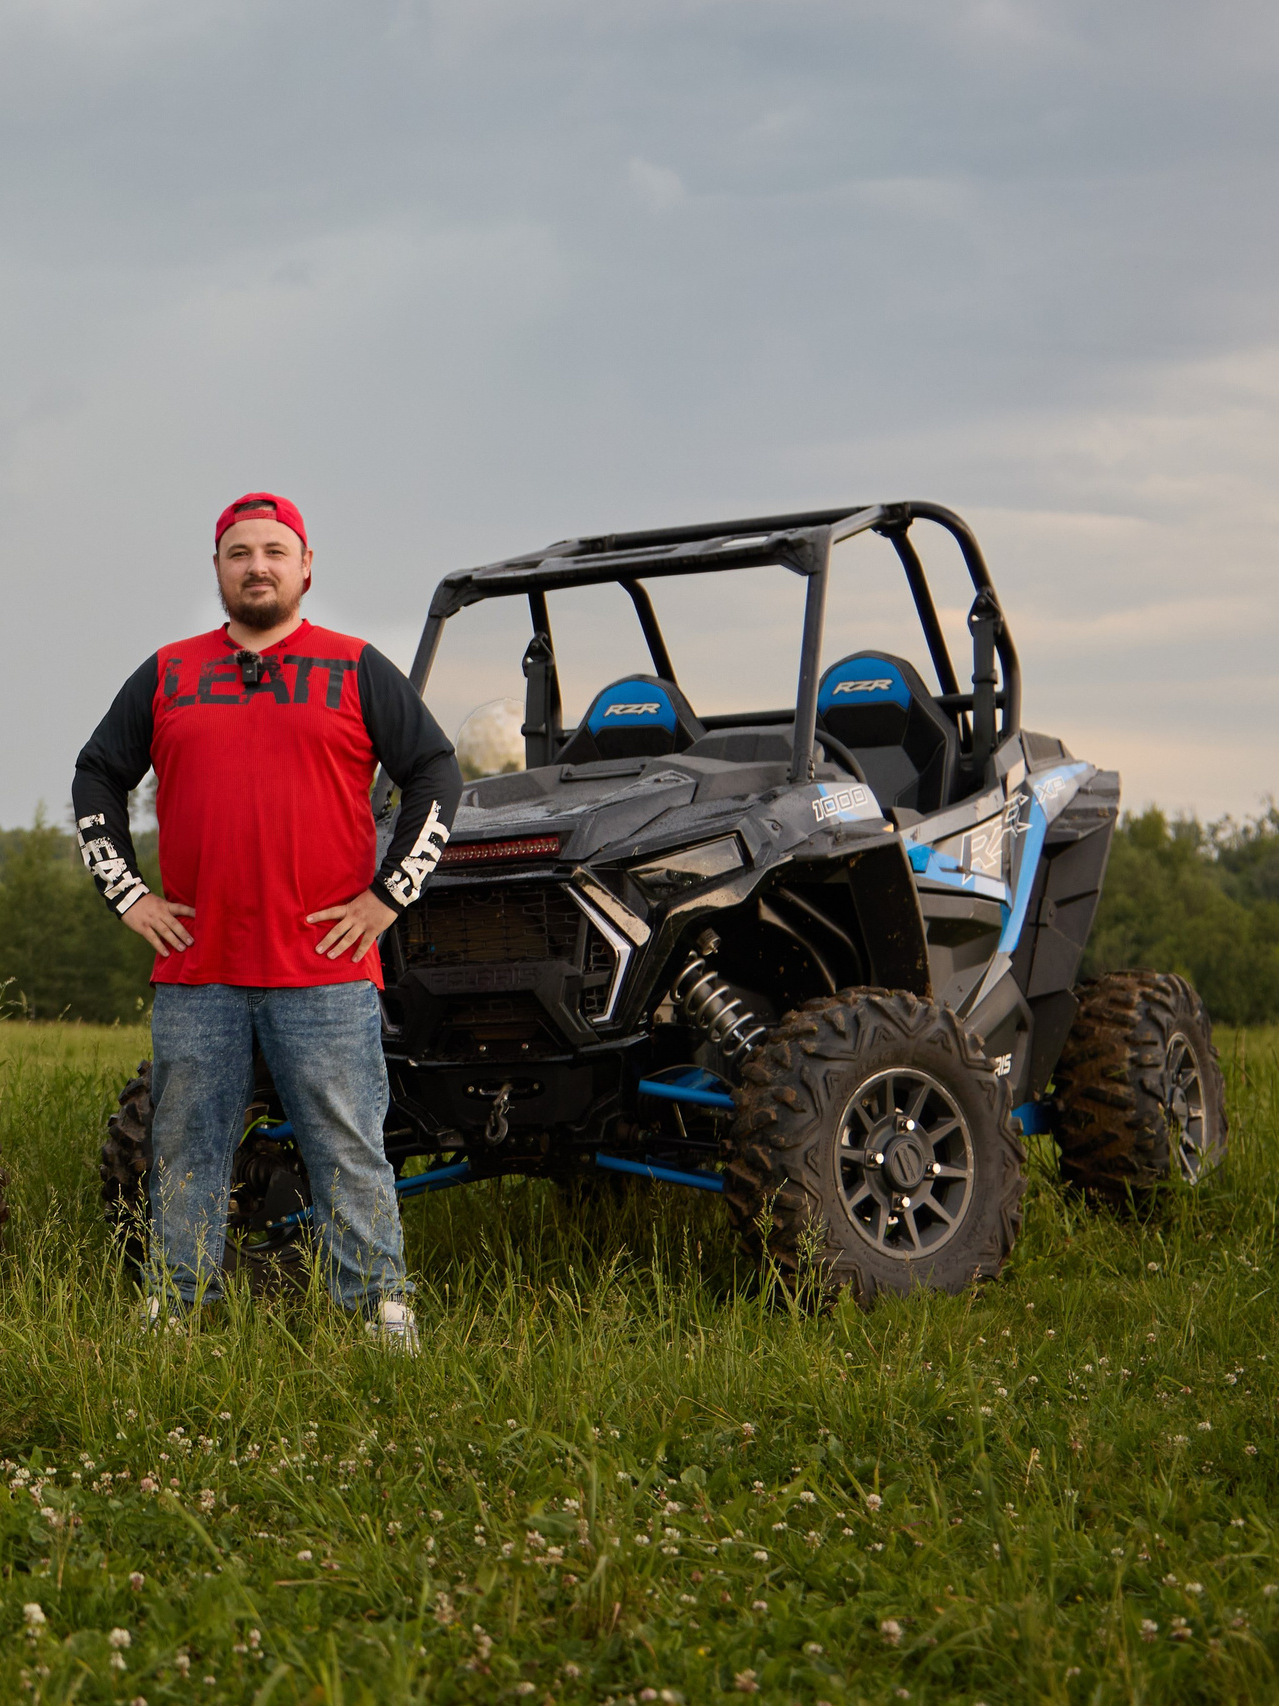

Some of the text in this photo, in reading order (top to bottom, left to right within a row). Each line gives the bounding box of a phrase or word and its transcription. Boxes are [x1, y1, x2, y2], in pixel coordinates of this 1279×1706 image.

[164, 654, 357, 712] LEATT
[832, 679, 893, 695] RZR
[603, 702, 661, 717] RZR
[812, 785, 868, 822] 1000
[1034, 776, 1066, 805] XP
[76, 812, 150, 914] LEATT
